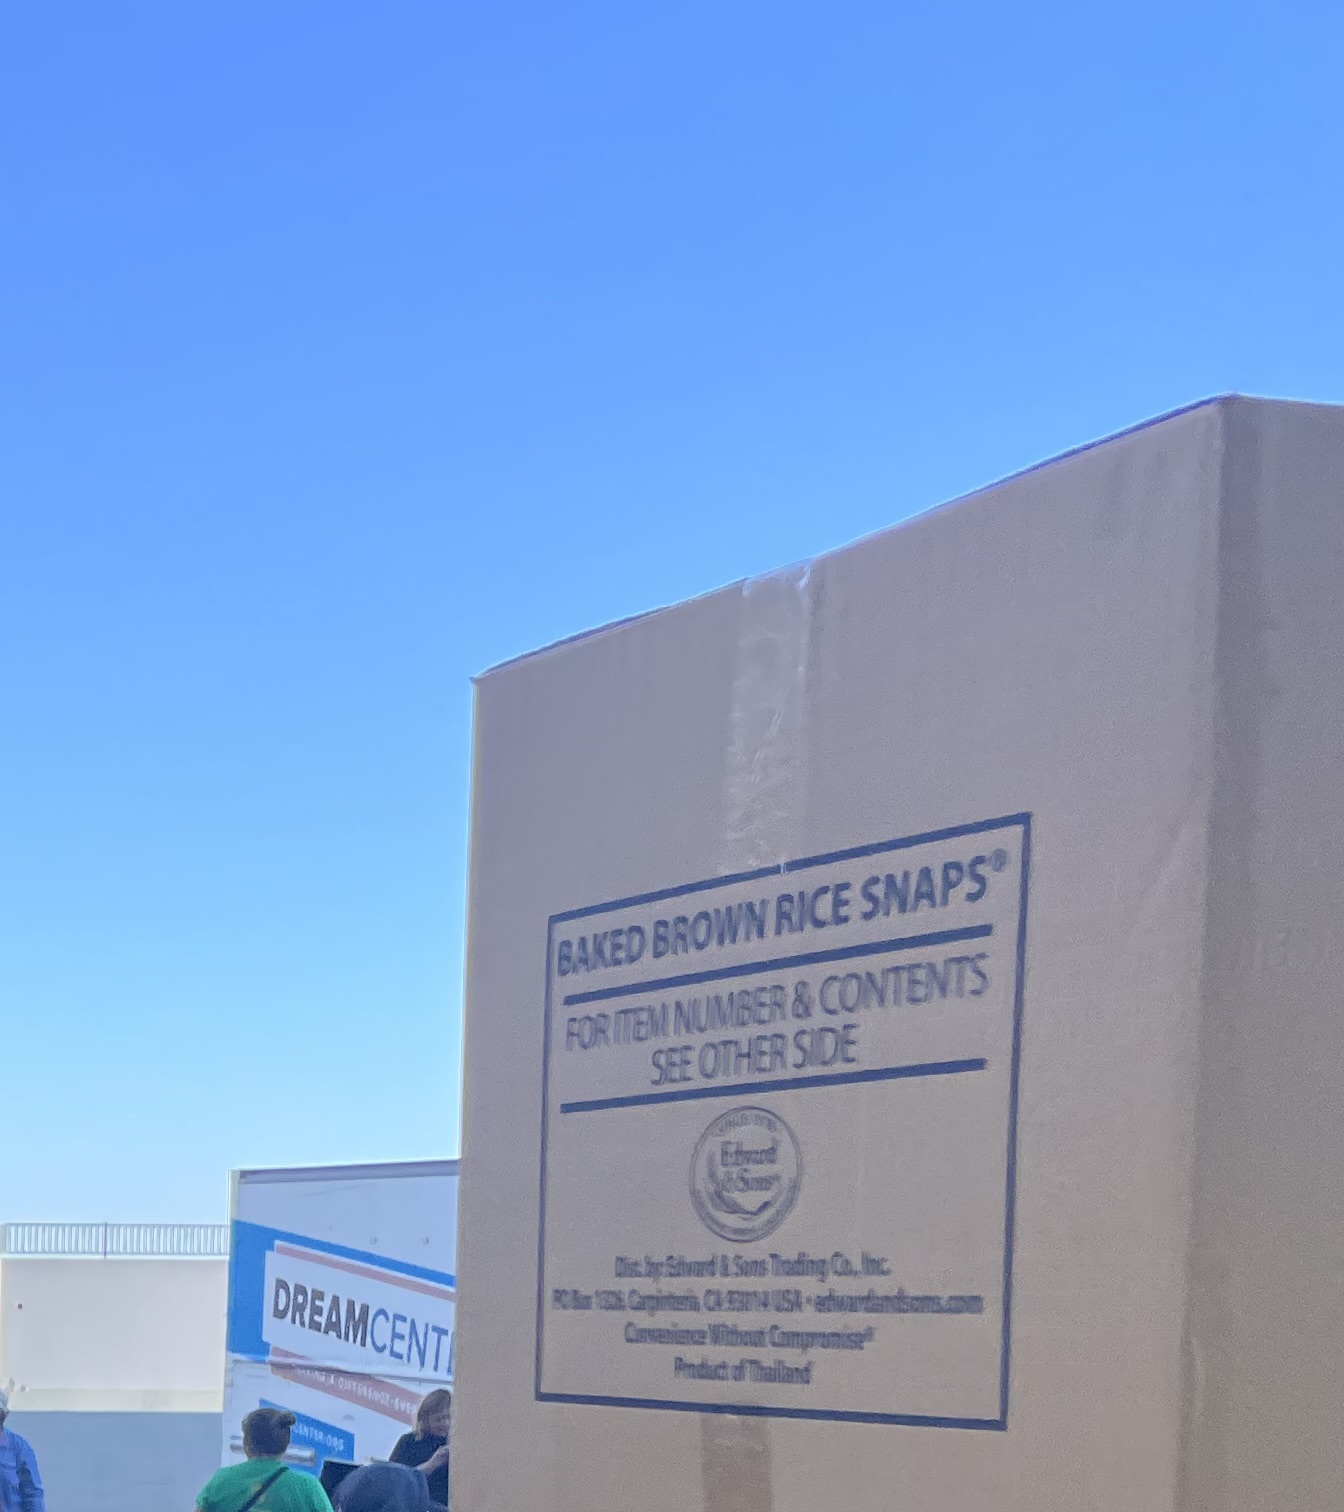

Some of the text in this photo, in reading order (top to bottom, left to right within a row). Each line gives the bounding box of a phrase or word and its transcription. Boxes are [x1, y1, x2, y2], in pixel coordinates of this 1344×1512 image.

[558, 925, 645, 977] BAKED
[652, 899, 769, 958] BROWN
[774, 882, 852, 936] RICE
[566, 952, 990, 1050] FOR ITEM NUMBER & CONTENTS
[650, 1023, 859, 1086] SEE OTHER SIDE
[272, 1277, 454, 1376] DREAMCENT
